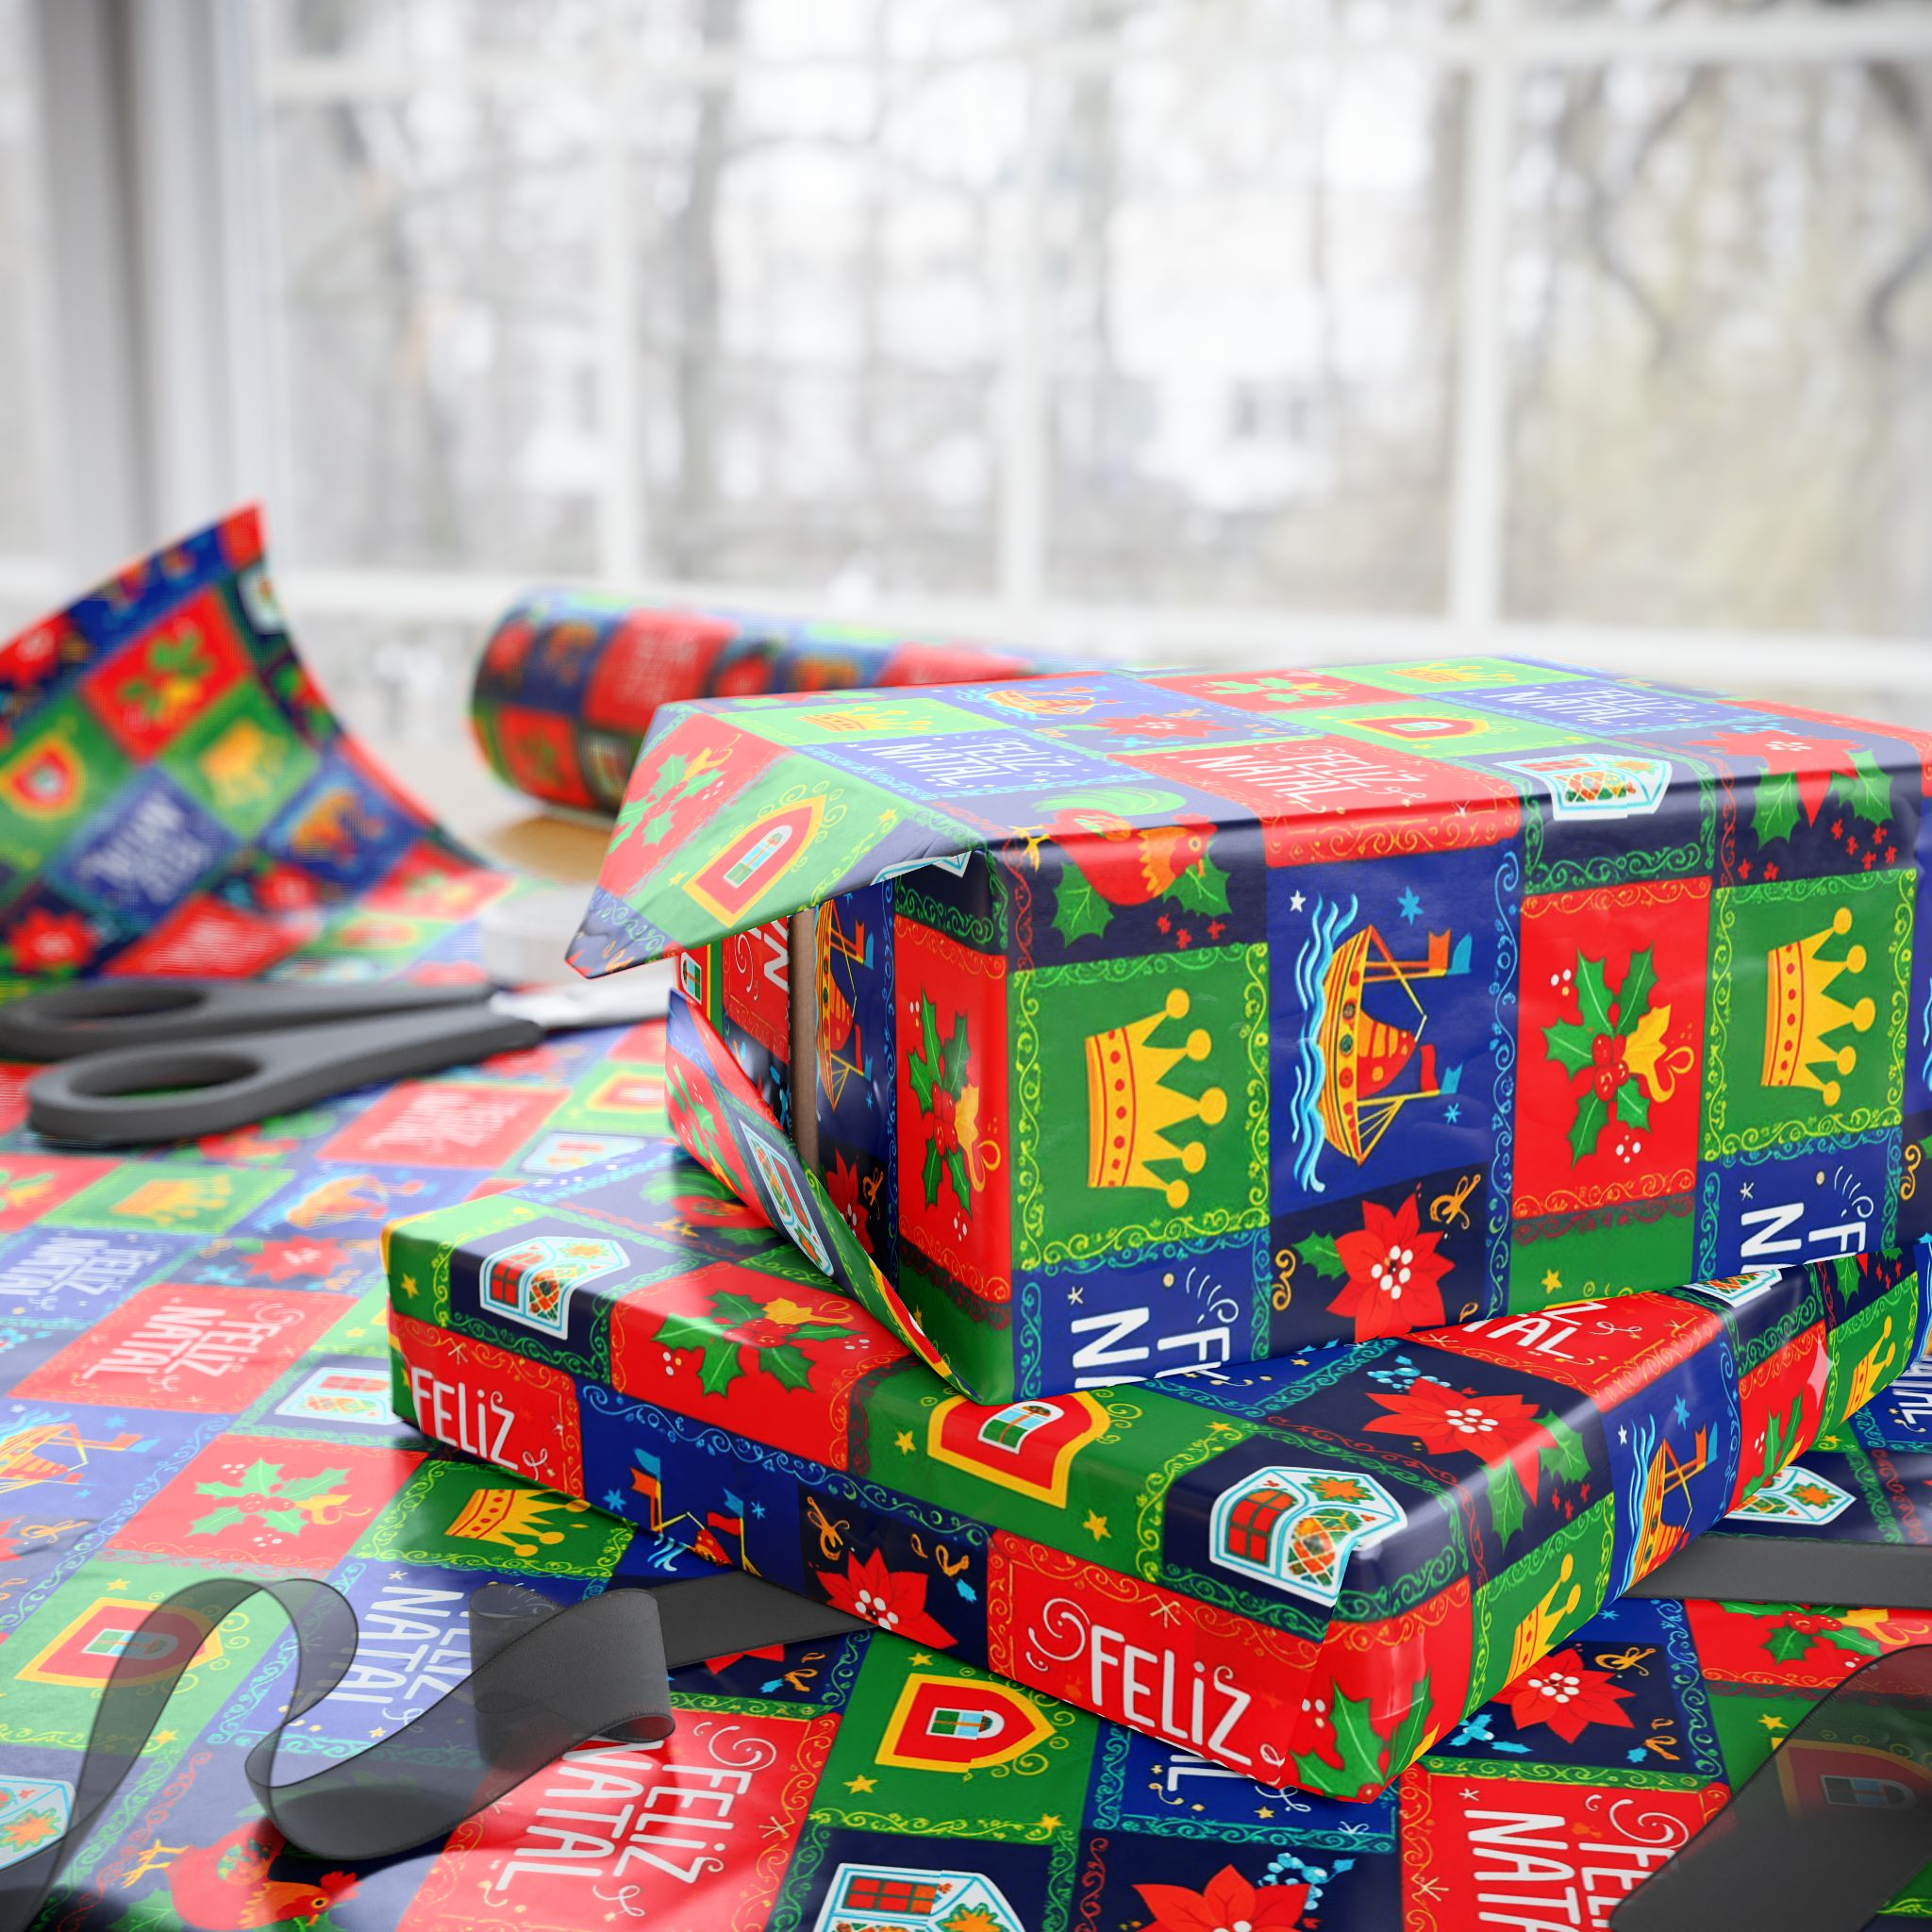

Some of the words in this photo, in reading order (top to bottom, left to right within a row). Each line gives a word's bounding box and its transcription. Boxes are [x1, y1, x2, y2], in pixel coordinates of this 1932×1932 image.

[1180, 754, 1358, 804] NATAL
[81, 1305, 227, 1380] NATAL
[495, 1735, 664, 1891] NATAL
[1463, 1809, 1582, 1932] NAT
